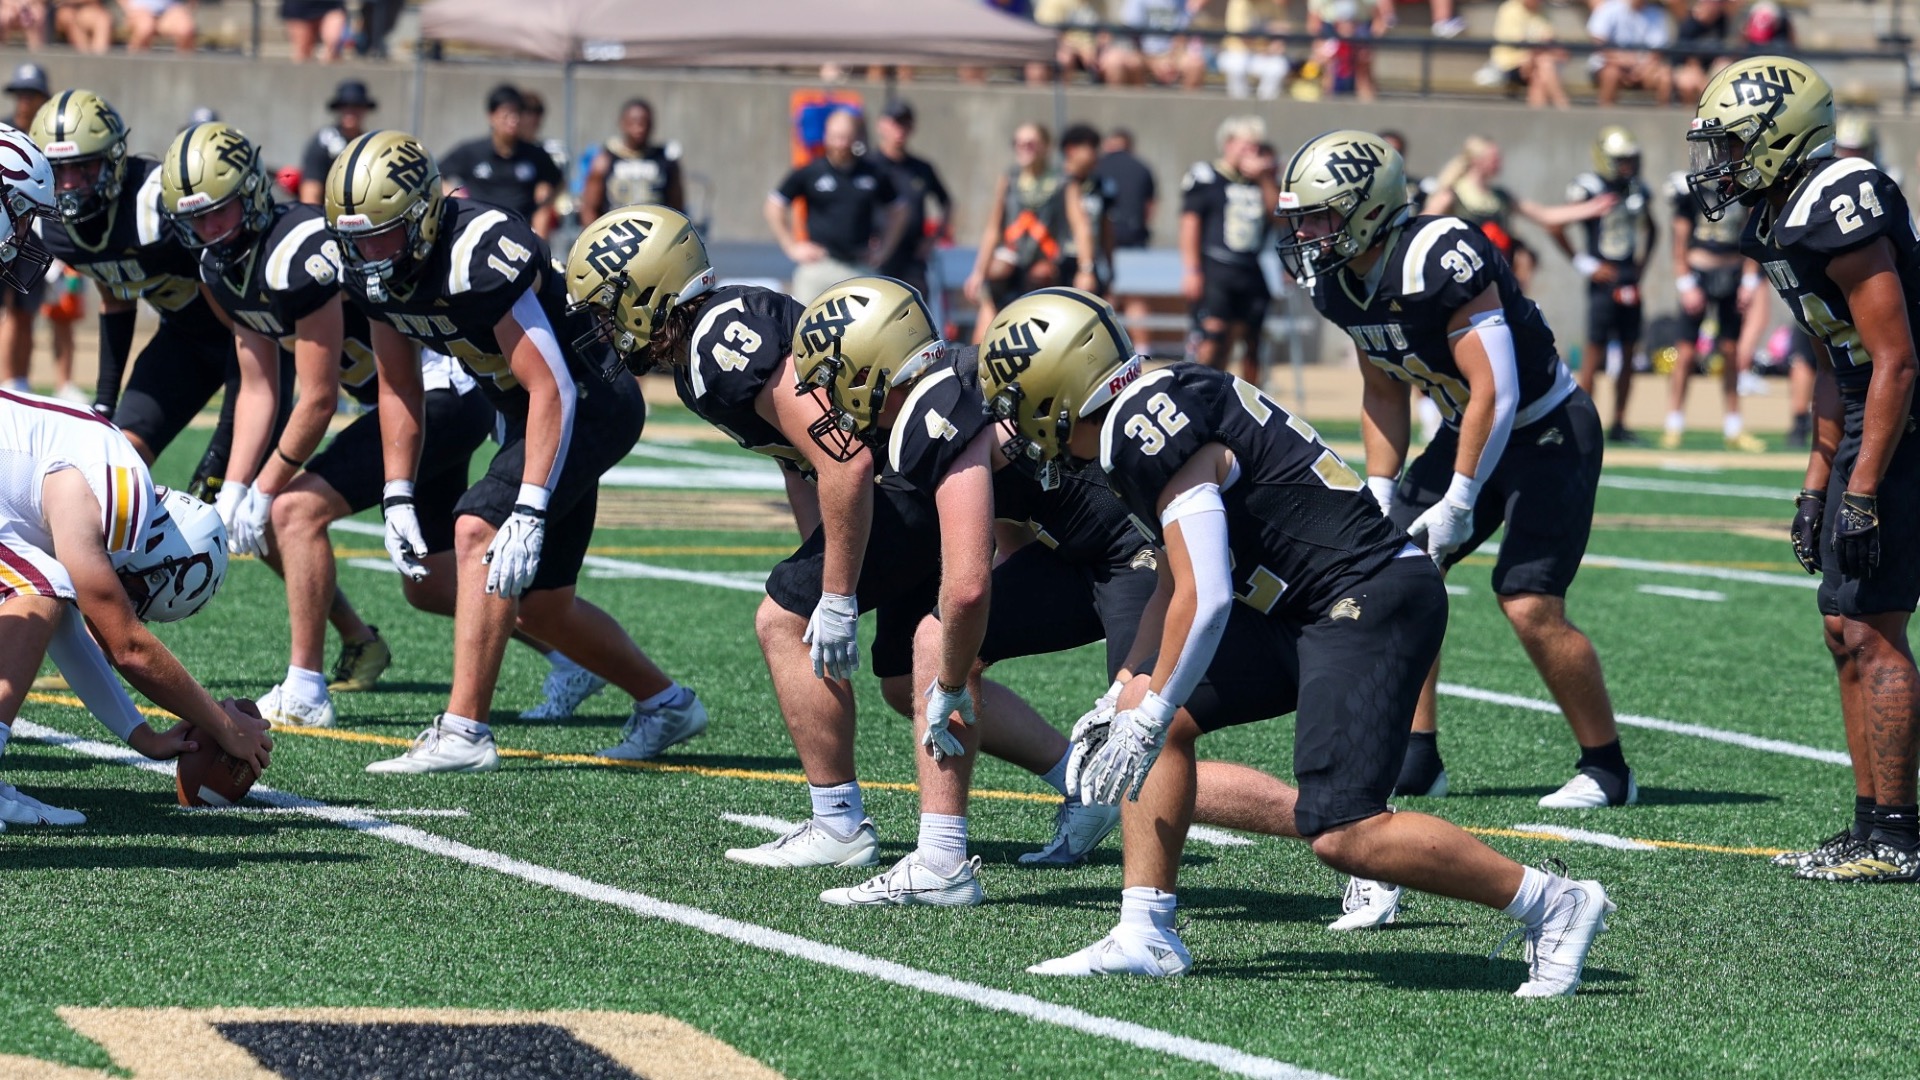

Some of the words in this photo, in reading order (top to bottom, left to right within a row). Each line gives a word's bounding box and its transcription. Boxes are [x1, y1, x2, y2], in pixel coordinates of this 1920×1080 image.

[1829, 181, 1884, 235] 24
[487, 235, 533, 284] 14
[1440, 239, 1485, 284] 31
[711, 320, 764, 373] 43
[1346, 323, 1409, 351] NWU
[924, 408, 960, 443] 4
[1123, 392, 1192, 456] 32
